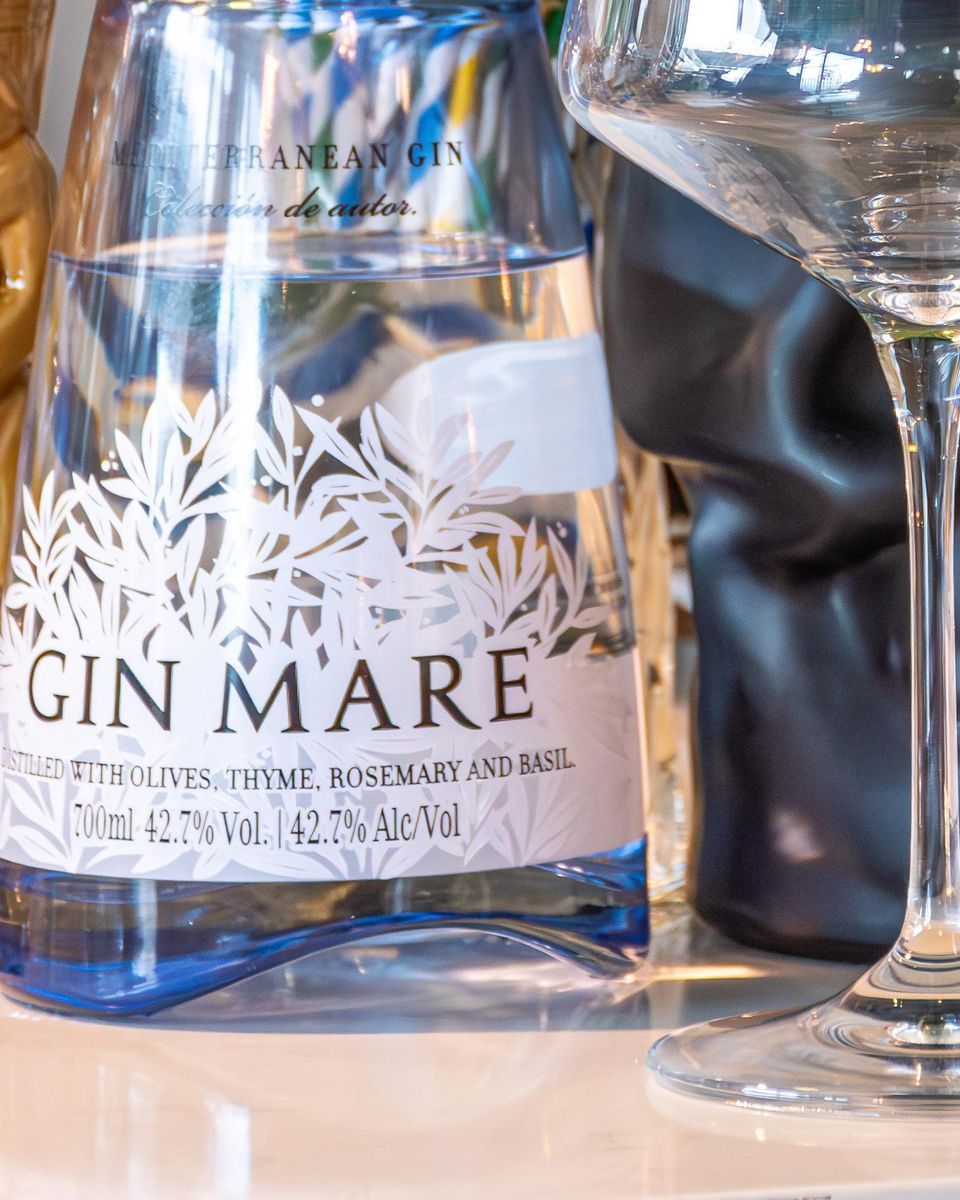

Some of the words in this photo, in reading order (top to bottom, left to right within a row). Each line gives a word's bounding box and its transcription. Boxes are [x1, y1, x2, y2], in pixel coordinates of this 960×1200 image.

[407, 141, 462, 168] GIN
[284, 187, 320, 218] de
[328, 193, 417, 217] autor.
[28, 649, 181, 732] GIN
[213, 646, 534, 734] MARE
[70, 760, 124, 786] WITH
[130, 765, 218, 792] OLIVES,
[226, 767, 320, 792] THYME,
[329, 760, 462, 789] ROSEMARY
[465, 756, 513, 782] AND
[74, 803, 134, 841] 700ml
[144, 809, 214, 846] 42.7%
[221, 810, 268, 846] Vol.
[290, 808, 367, 845] 42.7%
[372, 803, 461, 843] Alc/Vol
